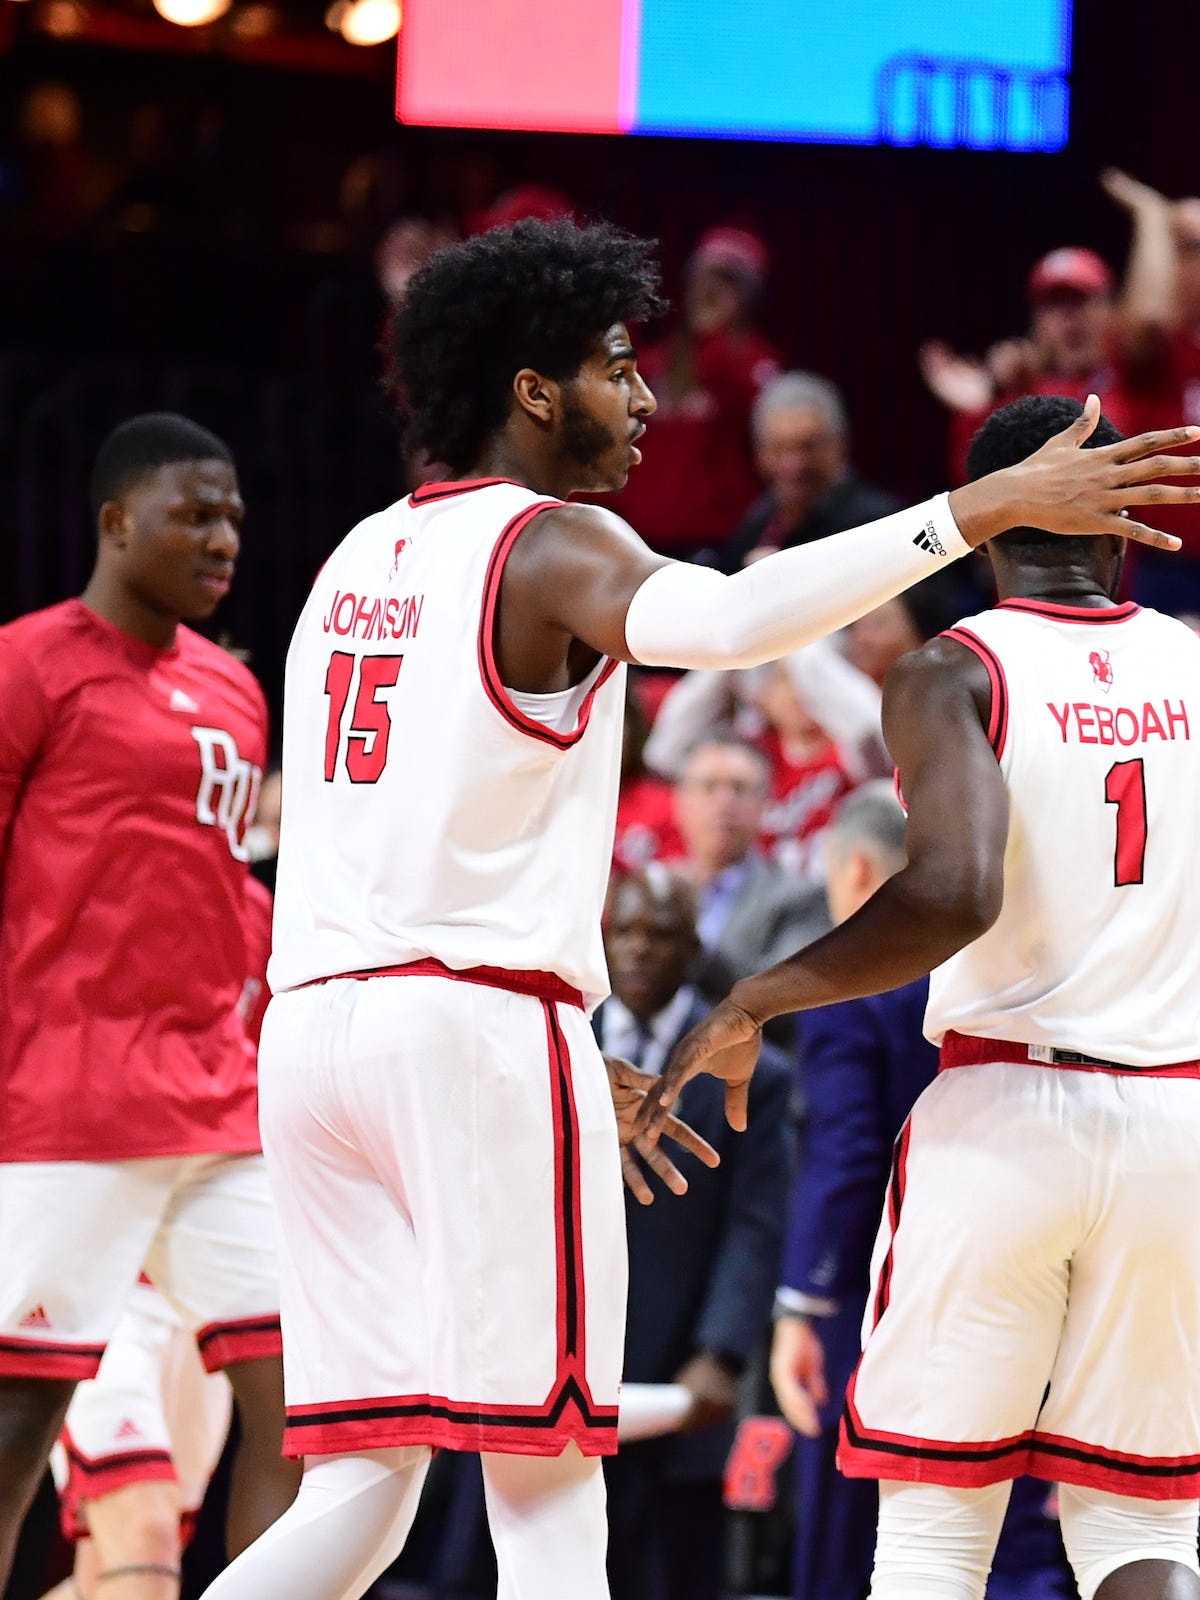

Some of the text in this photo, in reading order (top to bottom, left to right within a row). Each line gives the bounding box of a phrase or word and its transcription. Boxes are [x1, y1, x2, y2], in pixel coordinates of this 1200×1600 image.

[925, 520, 947, 556] adidas
[323, 590, 424, 641] JOHNSON
[324, 650, 404, 784] 15
[1046, 699, 1191, 746] YEBOAH
[1104, 757, 1148, 887] 1
